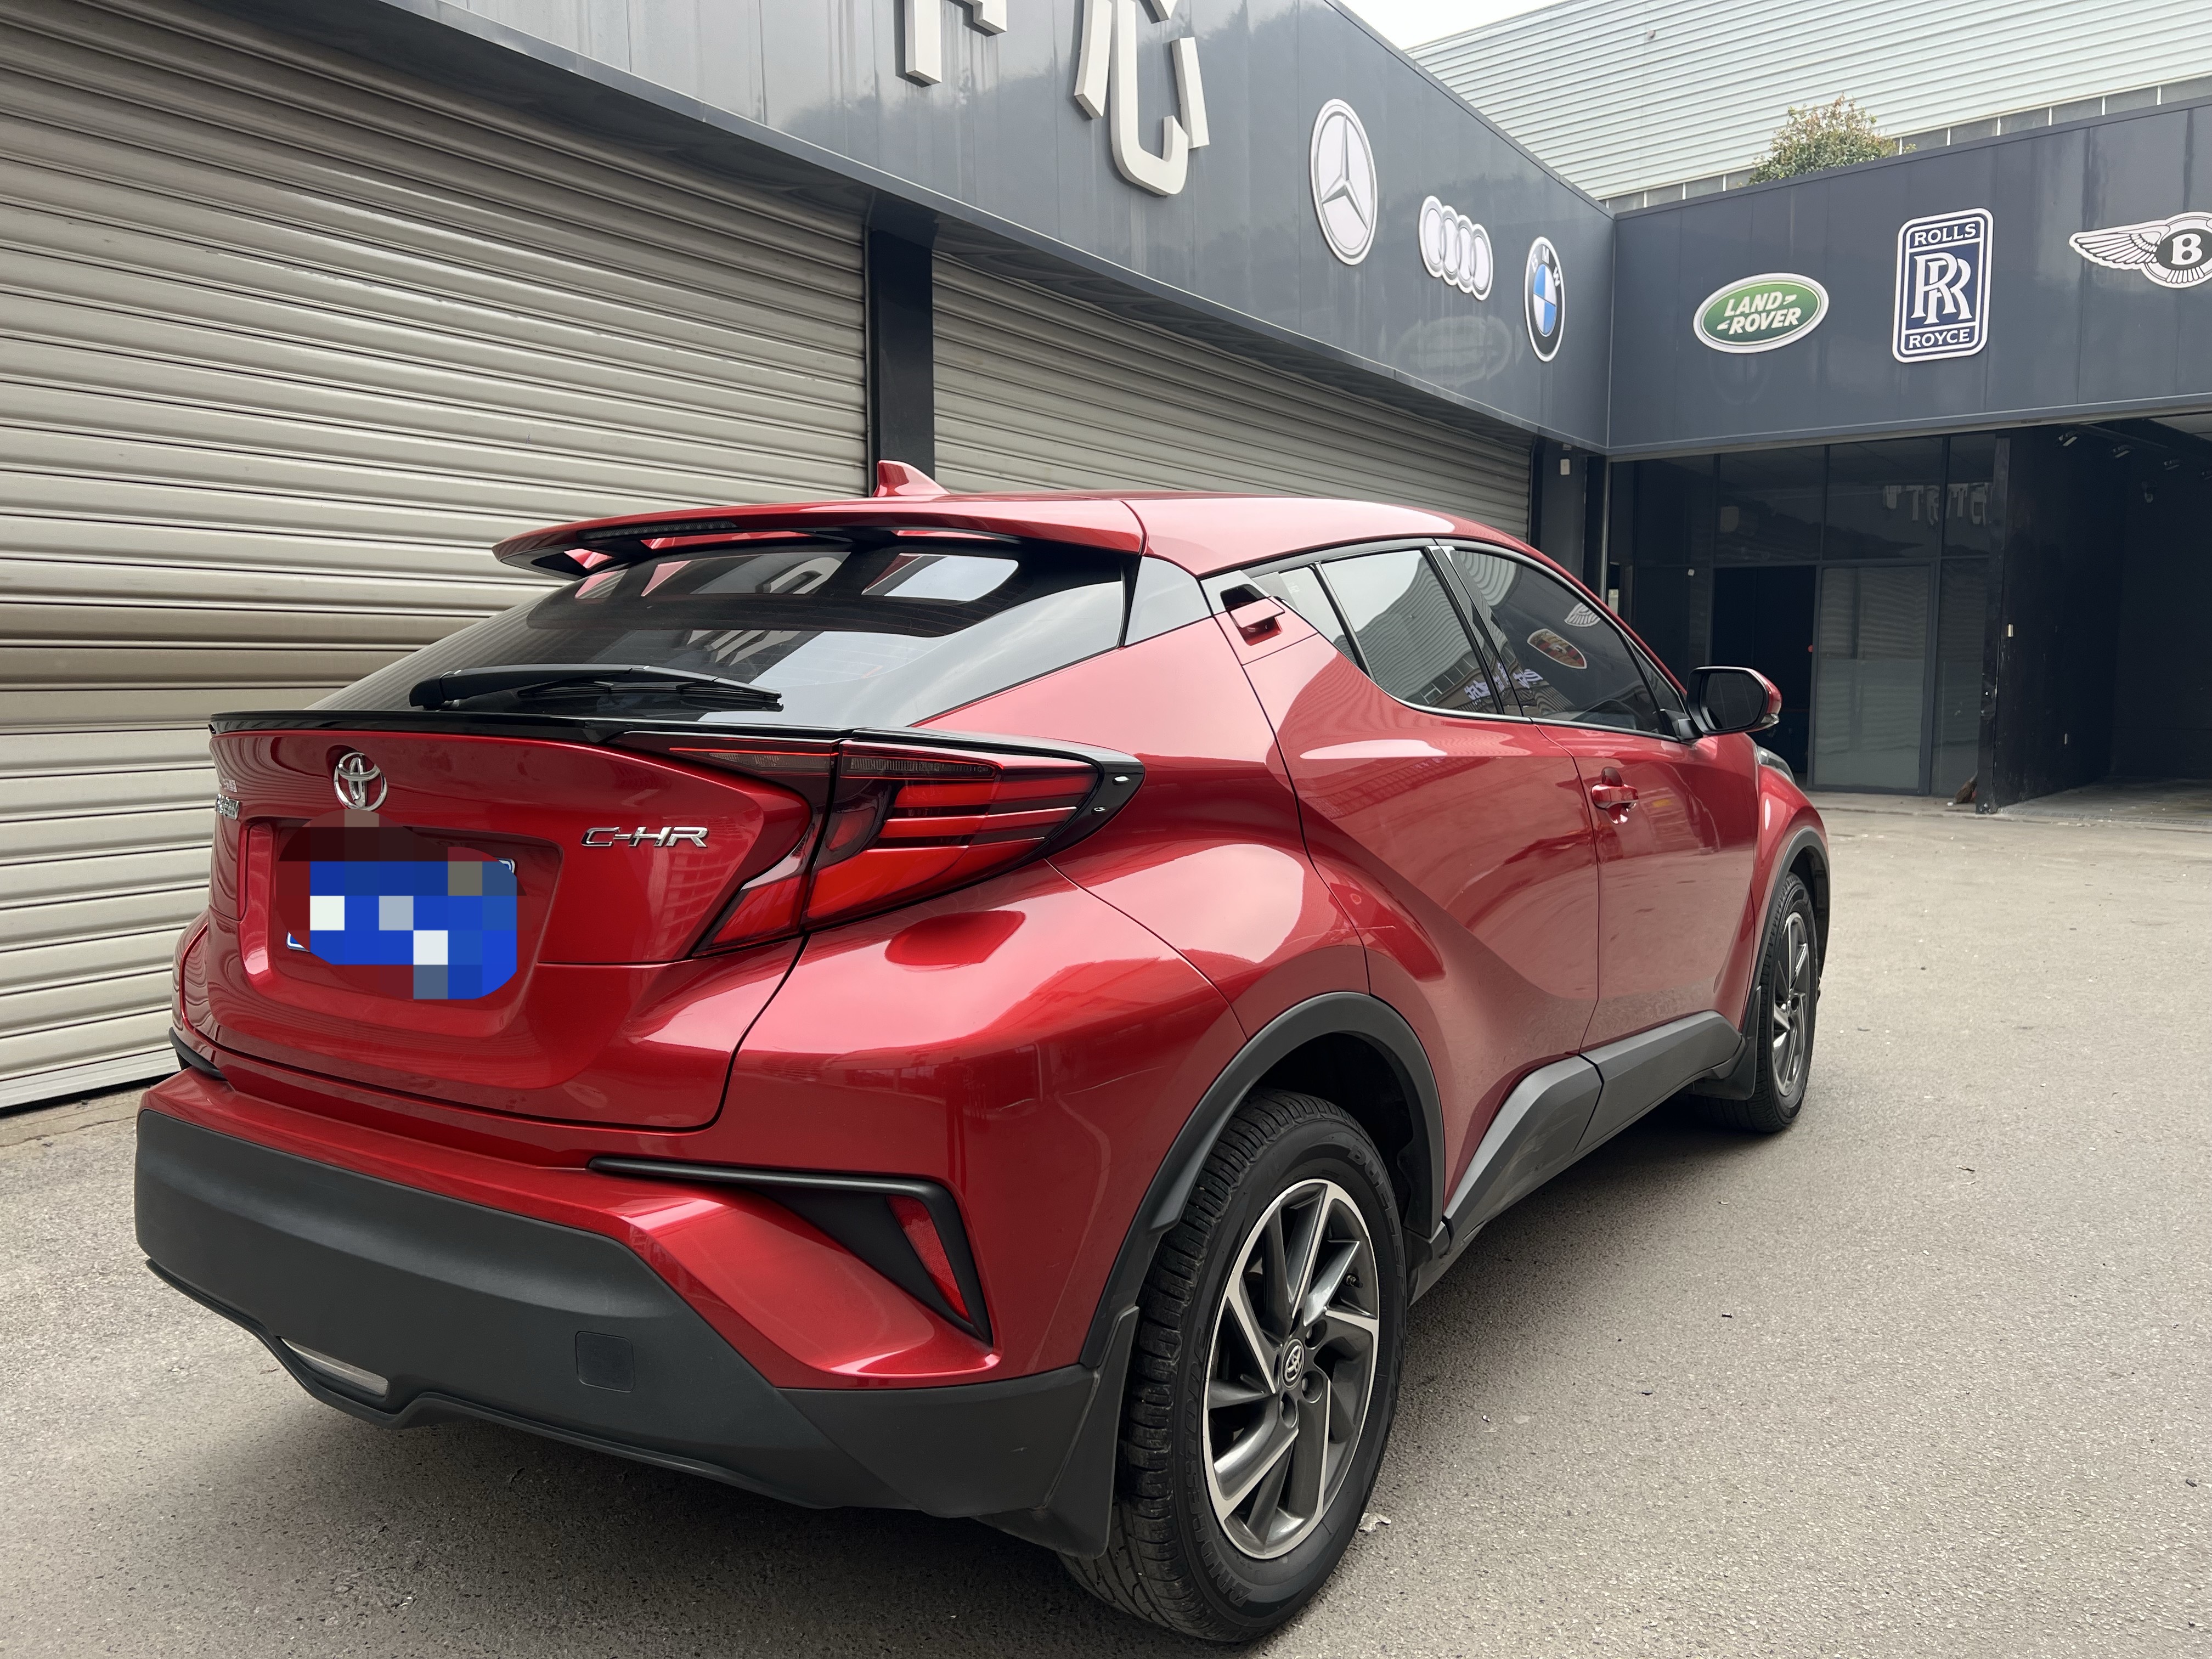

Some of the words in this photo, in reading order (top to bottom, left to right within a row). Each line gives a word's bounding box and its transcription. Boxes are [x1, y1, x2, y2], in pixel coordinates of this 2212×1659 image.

[1914, 223, 1976, 246] ROLLS
[2171, 233, 2203, 266] B
[1531, 245, 1560, 287] BMW
[1908, 328, 1970, 348] ROYCE
[581, 826, 708, 848] C-HR
[1186, 1326, 1253, 1607] BRIDGESTONE
